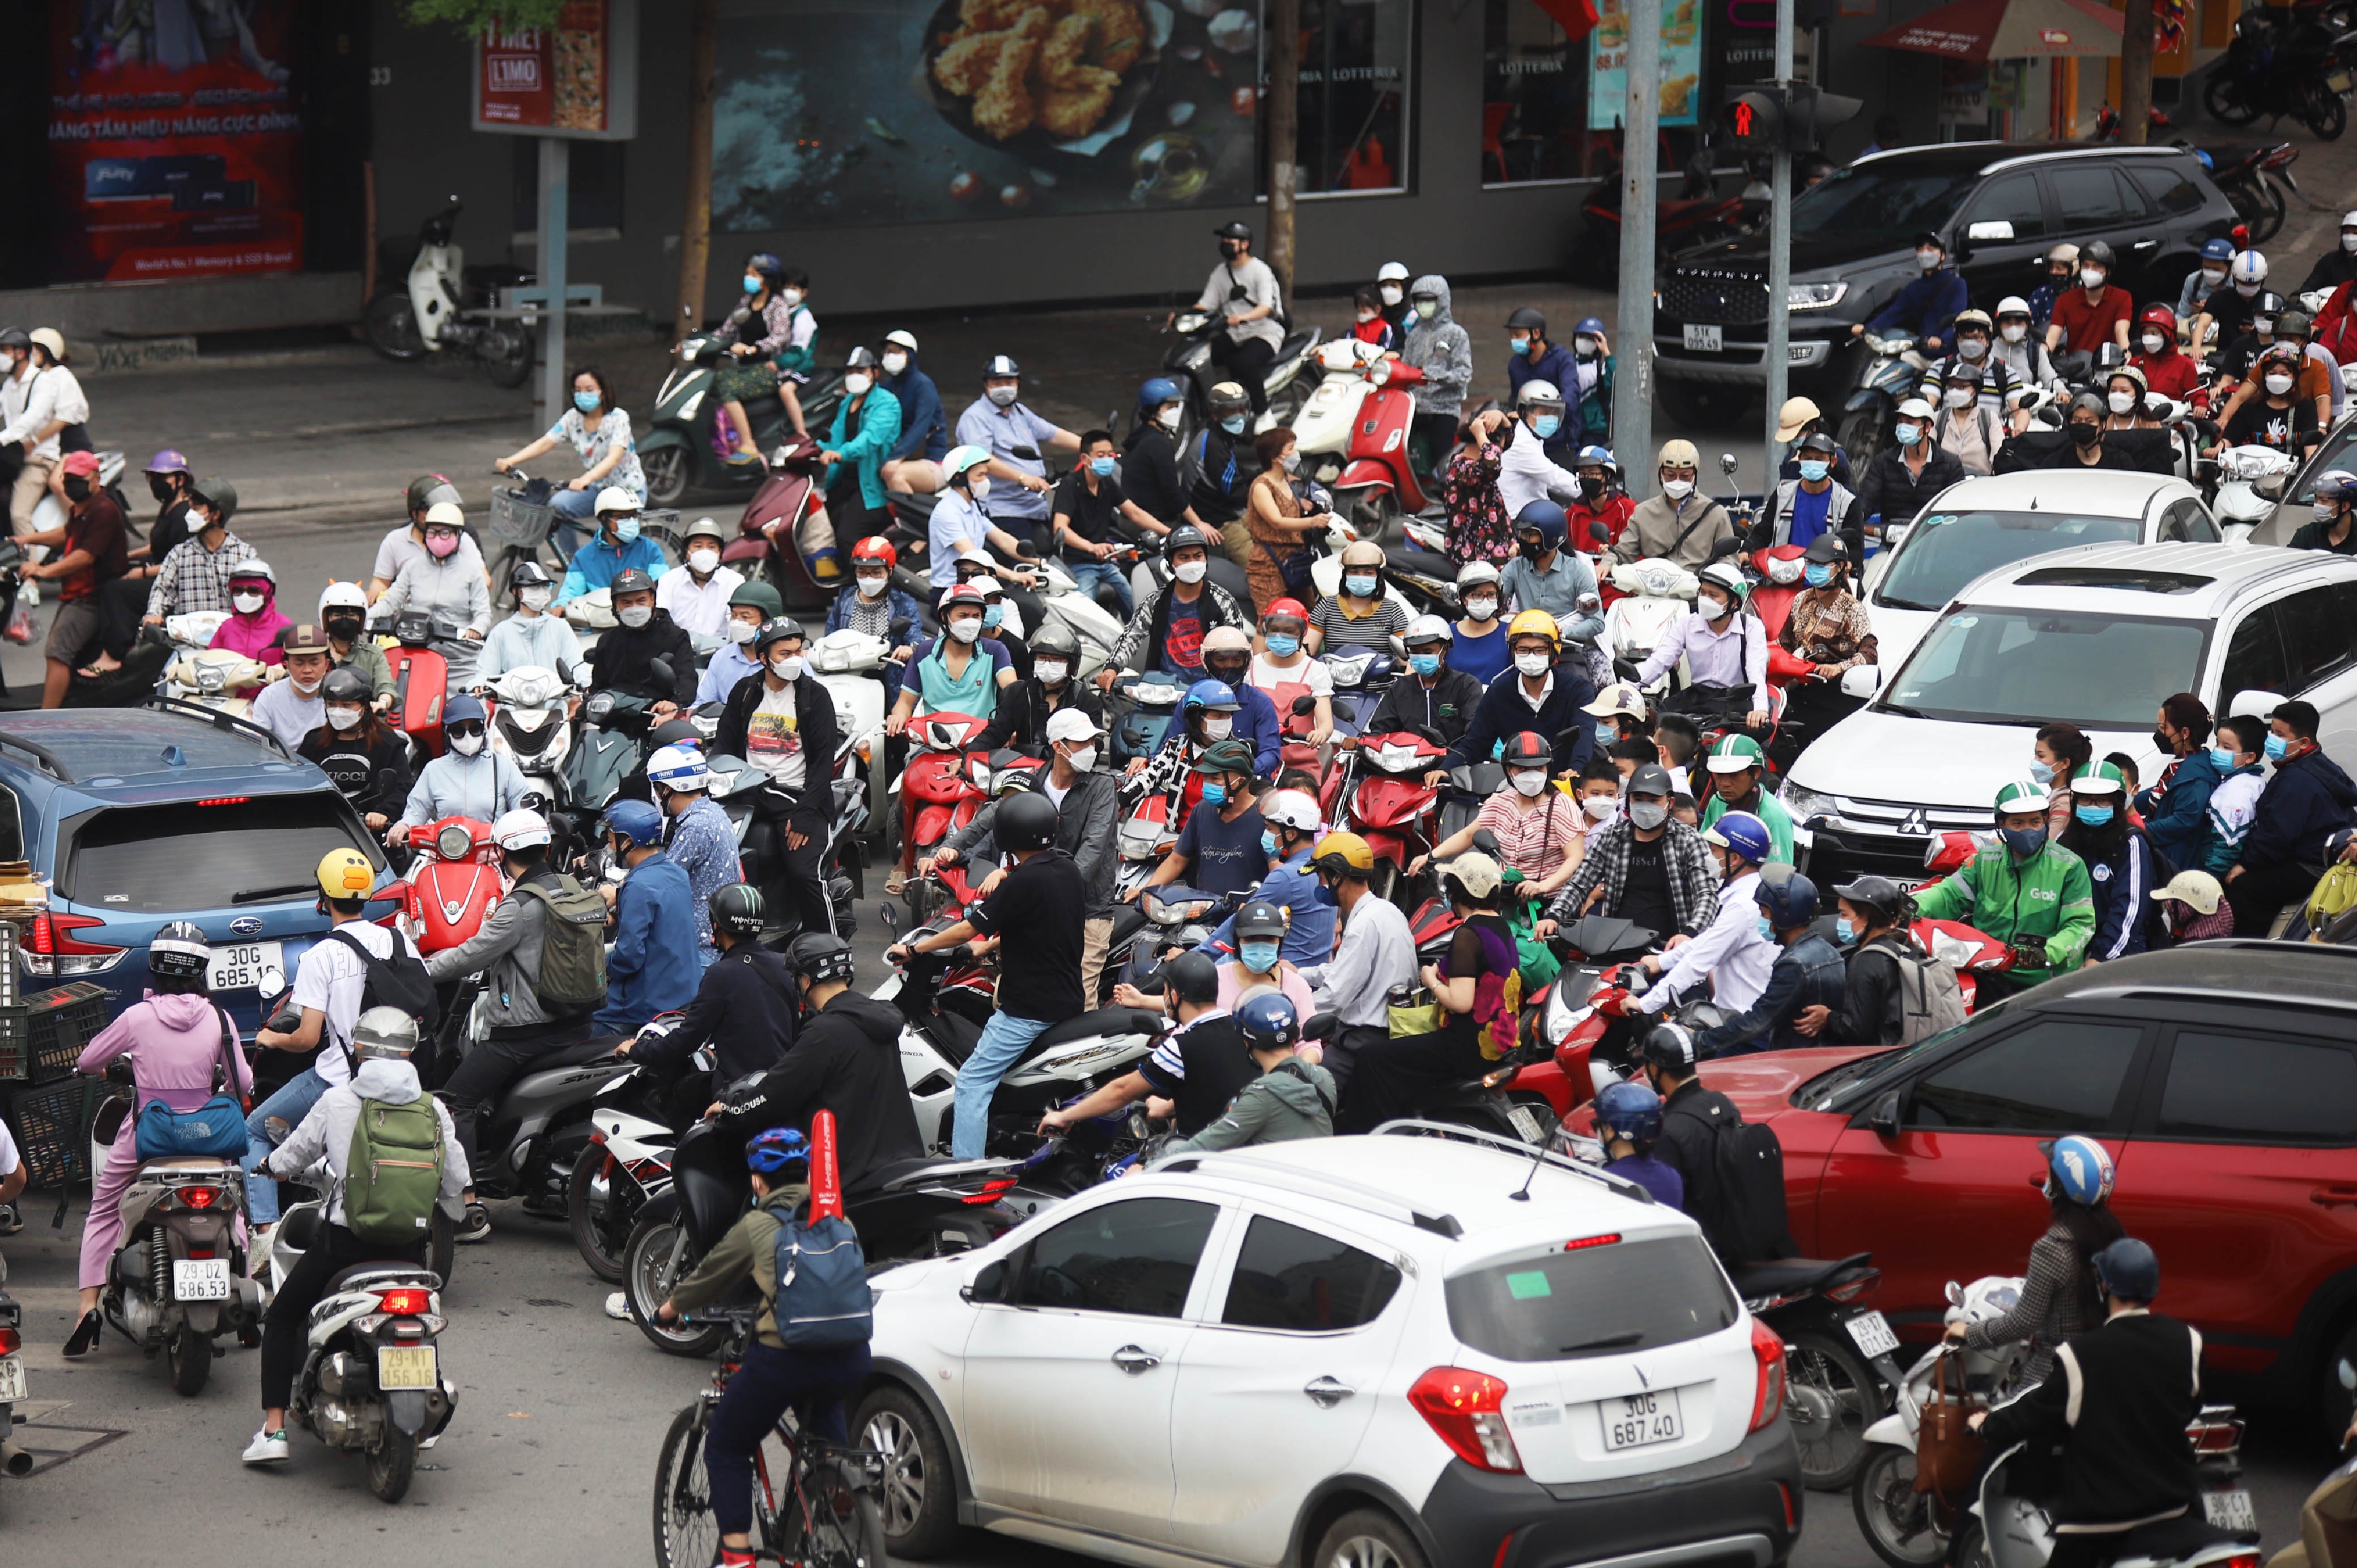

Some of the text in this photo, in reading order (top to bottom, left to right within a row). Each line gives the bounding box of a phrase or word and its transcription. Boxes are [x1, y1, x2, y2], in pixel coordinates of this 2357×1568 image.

[1726, 48, 1776, 63] LOTTER
[1333, 66, 1398, 83] LOTTERIA
[1499, 60, 1564, 75] LOTTERIA
[327, 772, 367, 782] UCCI
[657, 770, 674, 778] VNPAY
[2030, 887, 2057, 902] Grab
[228, 947, 261, 966] 30G
[183, 1263, 221, 1279] 29-D2
[178, 1281, 227, 1297] 586.53
[388, 1349, 427, 1367] 29-N1
[1614, 1415, 1674, 1445] 687.40
